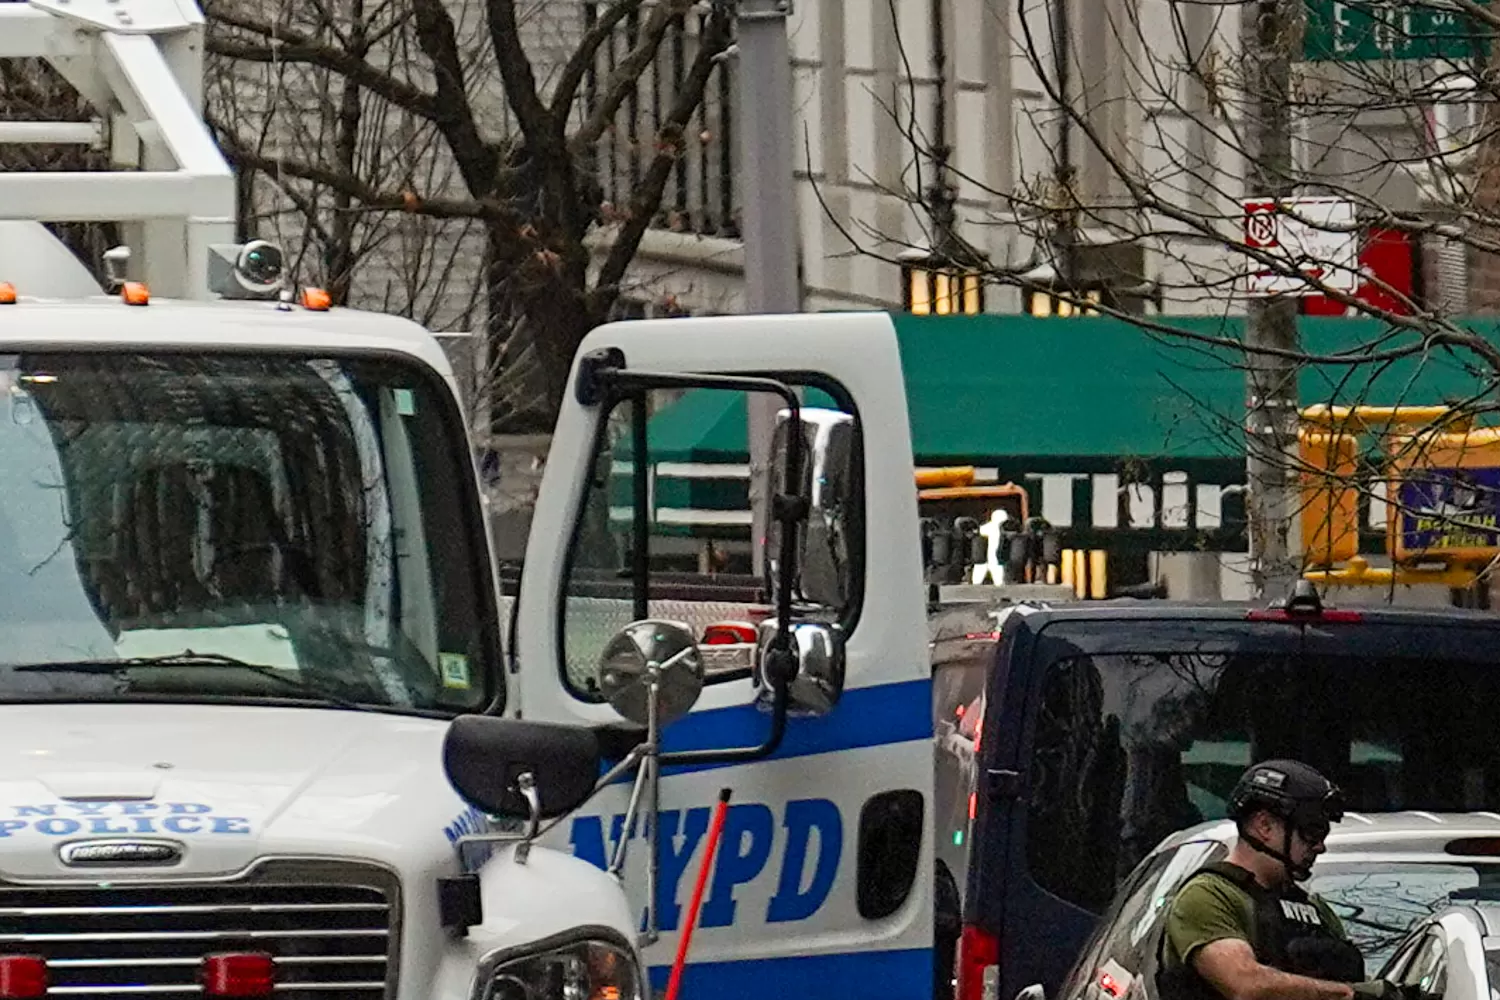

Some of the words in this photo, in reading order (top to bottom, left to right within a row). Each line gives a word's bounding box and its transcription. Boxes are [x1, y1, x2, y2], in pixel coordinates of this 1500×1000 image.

[1025, 471, 1250, 529] Thir
[12, 802, 213, 817] NYPD
[0, 815, 251, 838] POLICE
